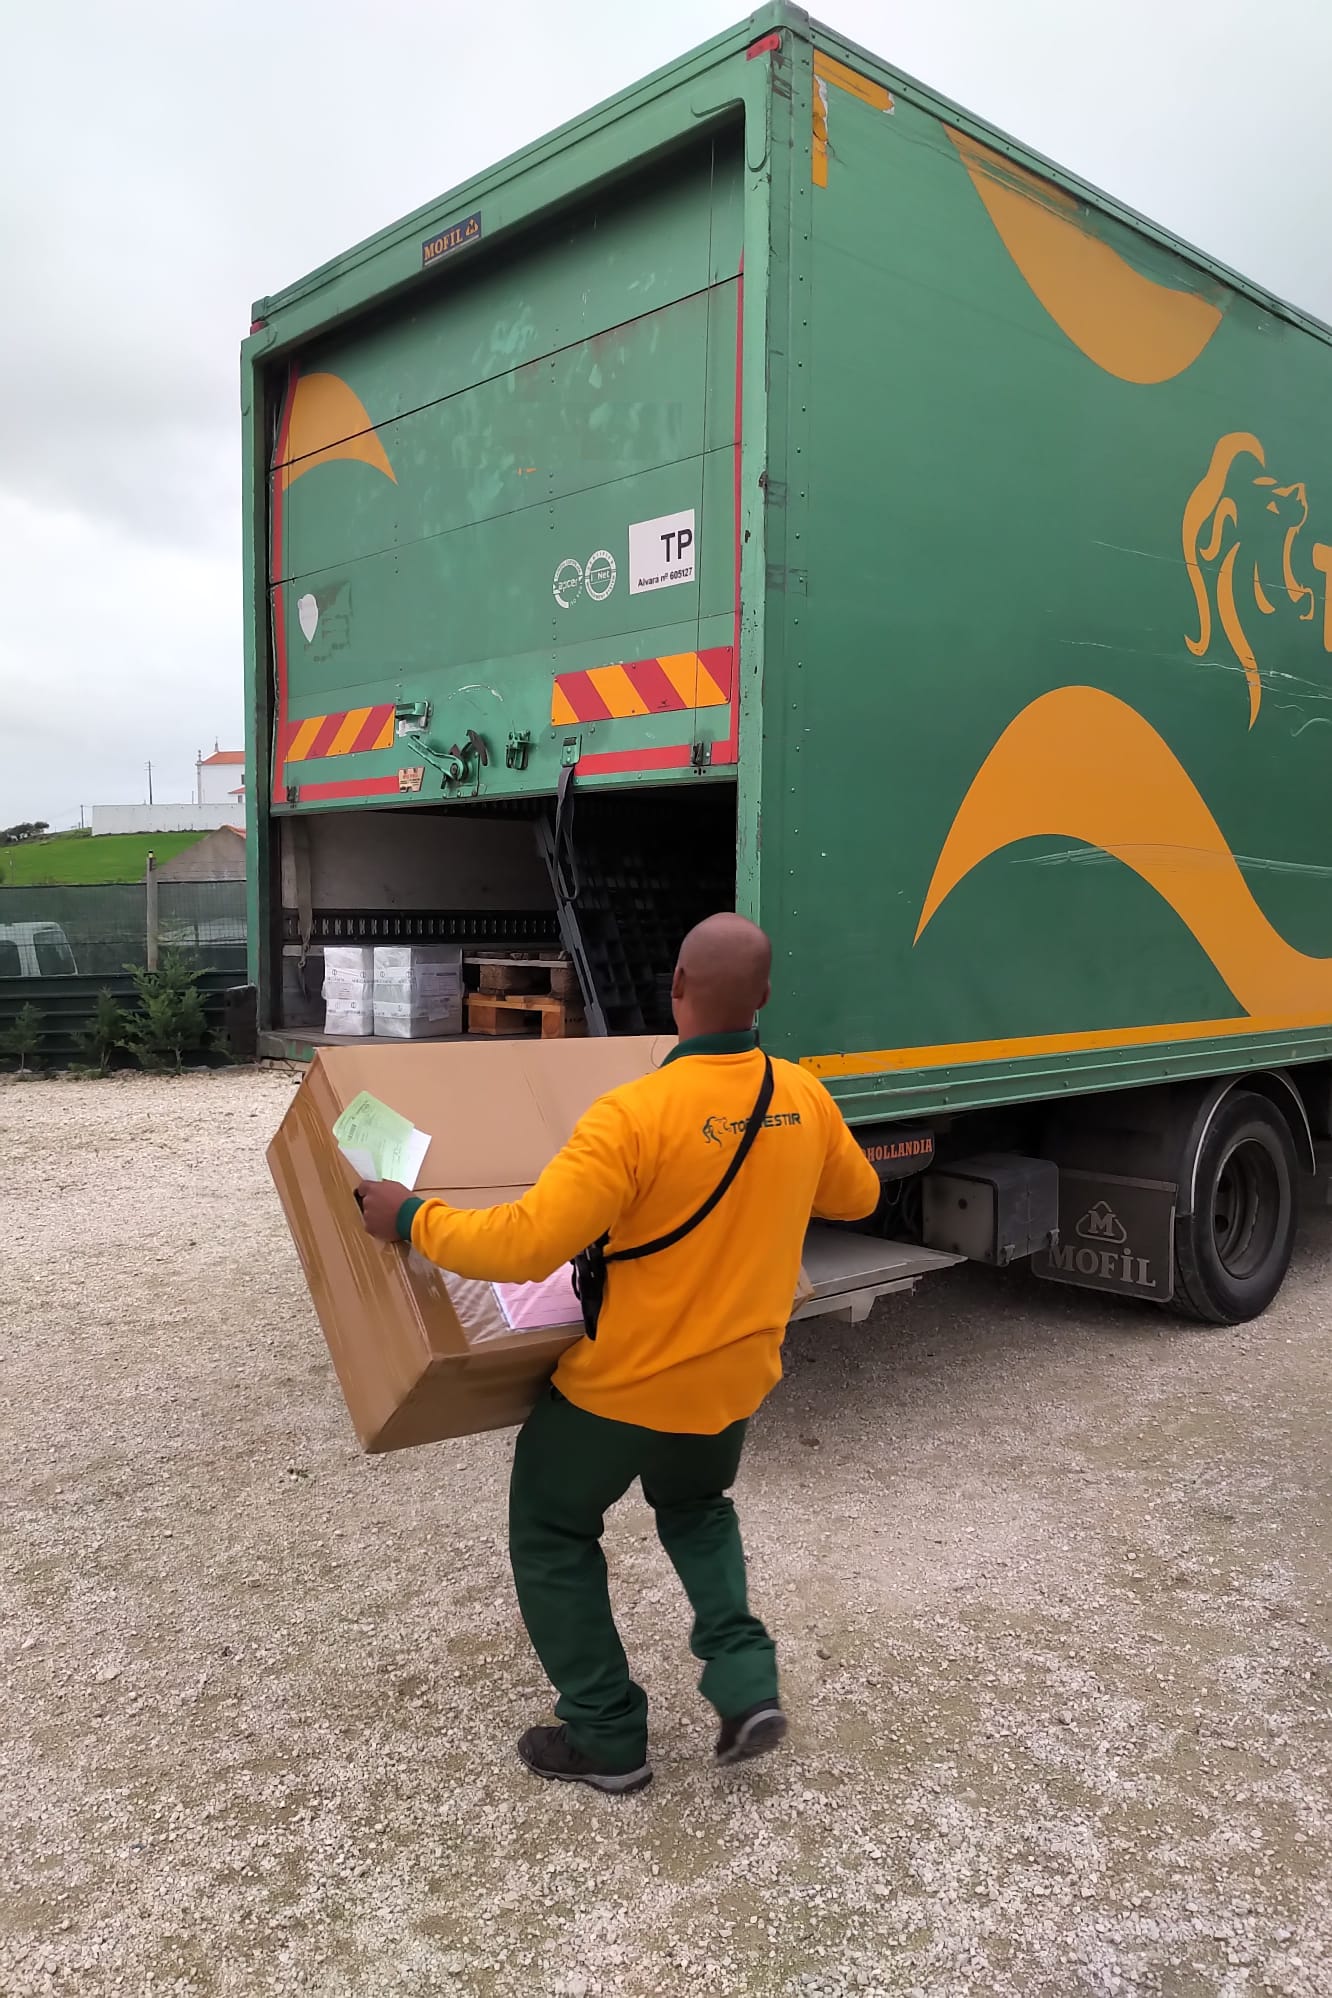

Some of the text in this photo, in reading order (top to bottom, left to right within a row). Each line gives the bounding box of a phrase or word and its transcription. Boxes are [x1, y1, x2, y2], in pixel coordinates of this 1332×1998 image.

[660, 528, 693, 562] TP
[669, 567, 693, 581] 605127
[863, 1138, 933, 1162] HOLLANDIA
